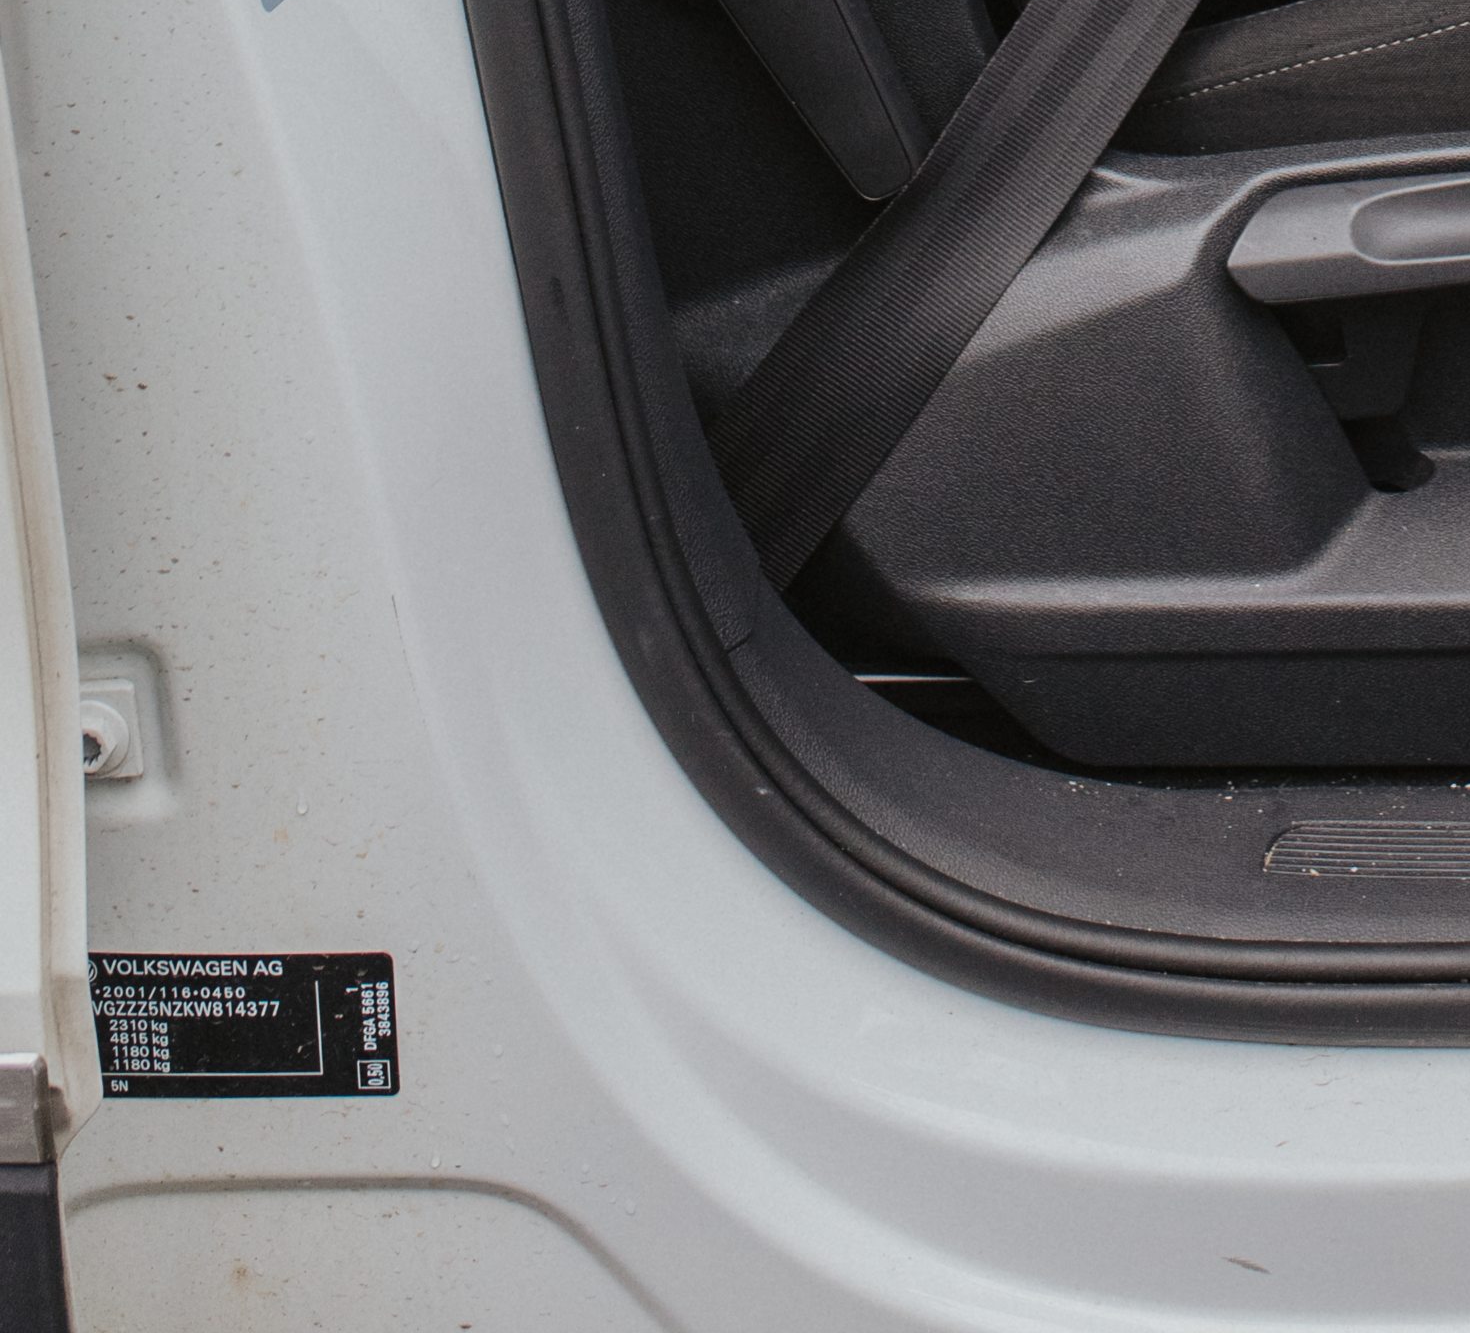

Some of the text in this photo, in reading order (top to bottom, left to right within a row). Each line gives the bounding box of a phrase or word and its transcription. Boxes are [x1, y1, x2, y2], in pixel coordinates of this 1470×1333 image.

[102, 958, 283, 977] VOLKSWAGEN AG
[376, 980, 391, 1037] 3843896
[361, 982, 377, 1051] DFGA 5661
[109, 1019, 168, 1034] 2310 kg
[152, 1033, 169, 1047] kg
[112, 1045, 170, 1060] 1180 kg
[113, 1058, 171, 1073] 1180 kg
[111, 1079, 129, 1092] 5N
